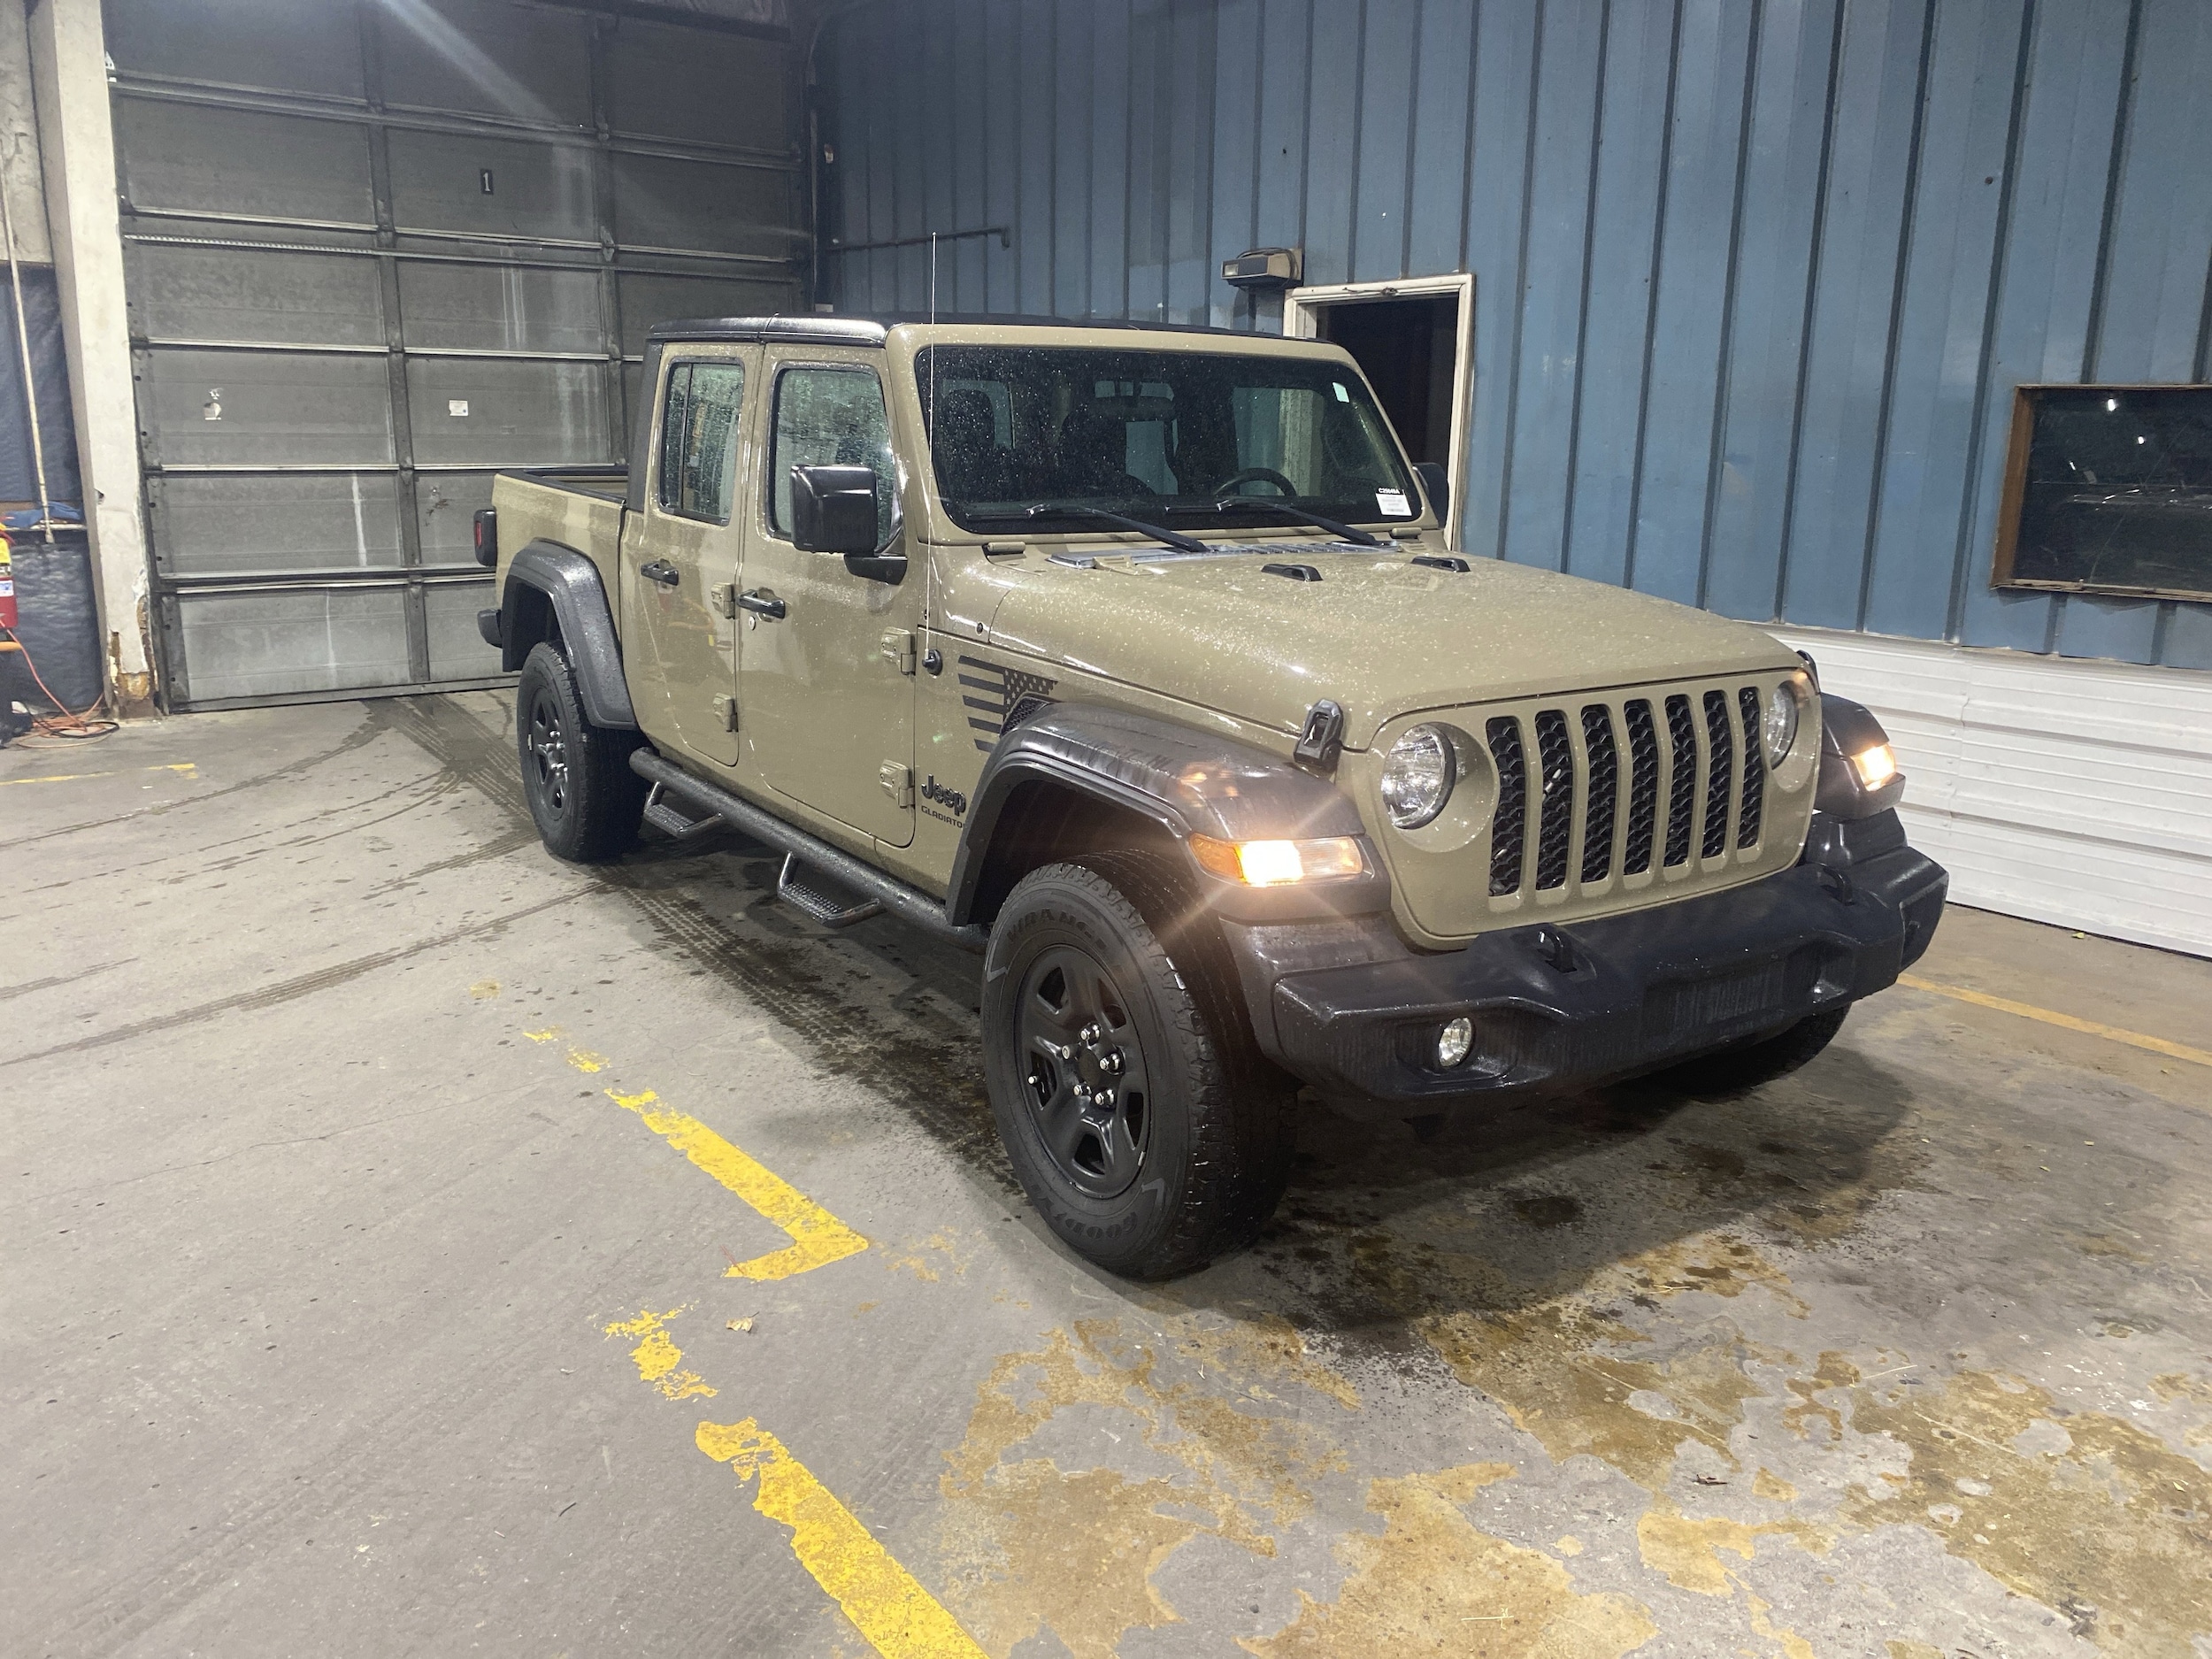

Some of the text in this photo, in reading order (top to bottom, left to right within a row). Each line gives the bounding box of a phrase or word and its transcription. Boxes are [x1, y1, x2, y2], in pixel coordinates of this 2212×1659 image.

[482, 172, 491, 191] 1
[921, 773, 966, 817] Jeep
[921, 805, 963, 828] GLADIATO
